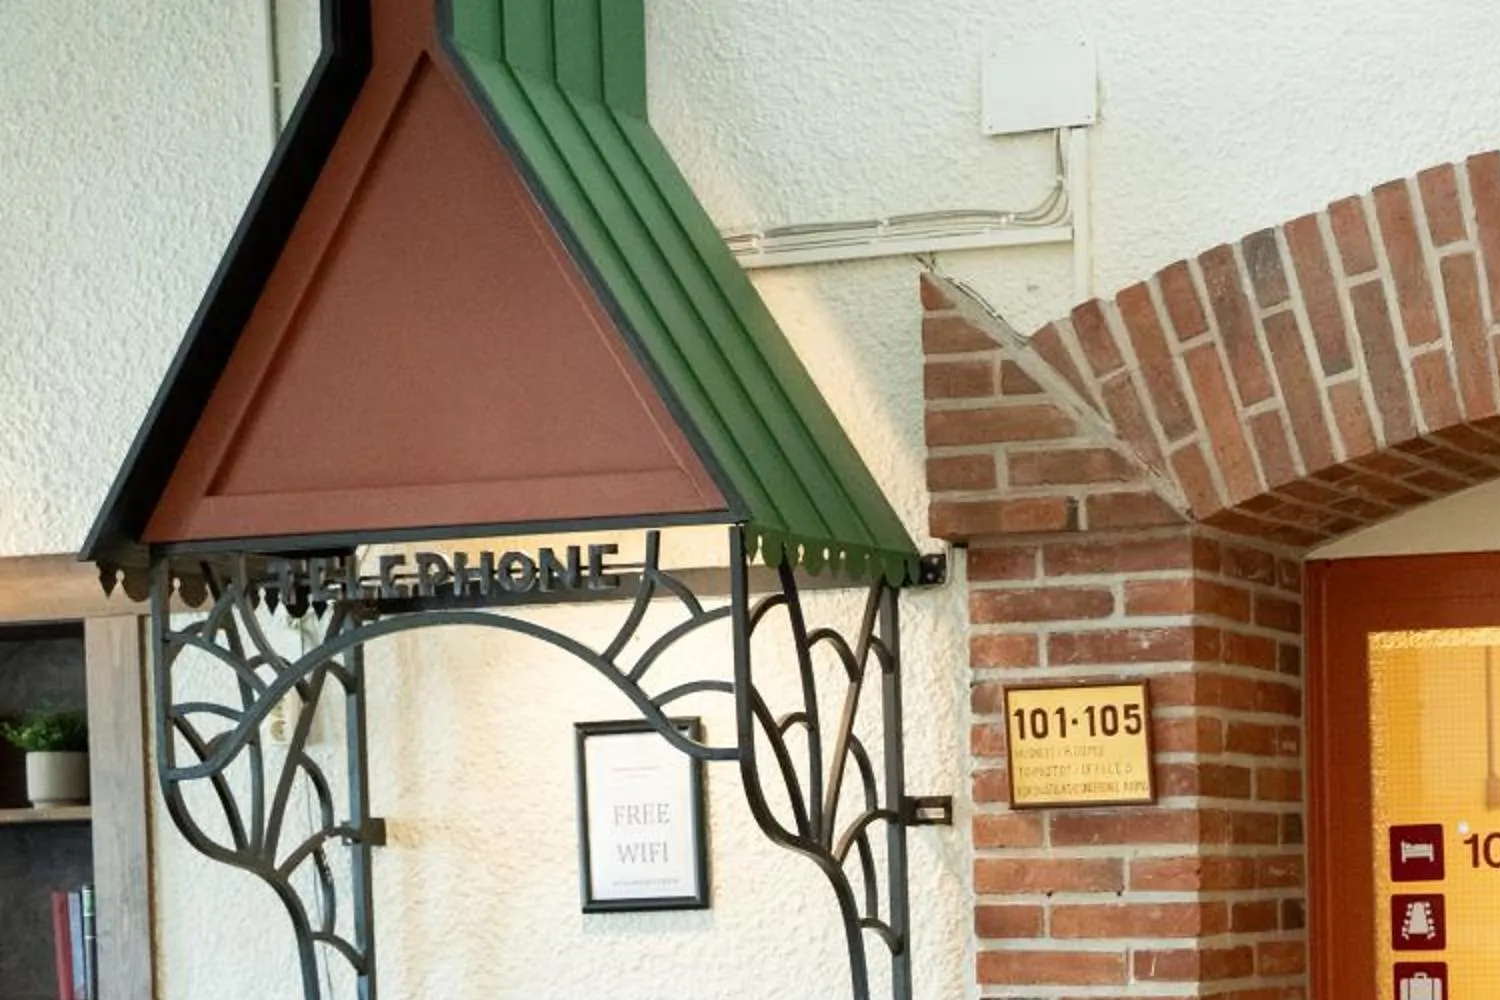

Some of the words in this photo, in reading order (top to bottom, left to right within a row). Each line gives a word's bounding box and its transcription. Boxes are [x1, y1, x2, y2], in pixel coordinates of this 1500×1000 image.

[267, 544, 619, 604] TELEPHONE
[613, 803, 671, 826] FREE
[617, 842, 669, 865] WIFI
